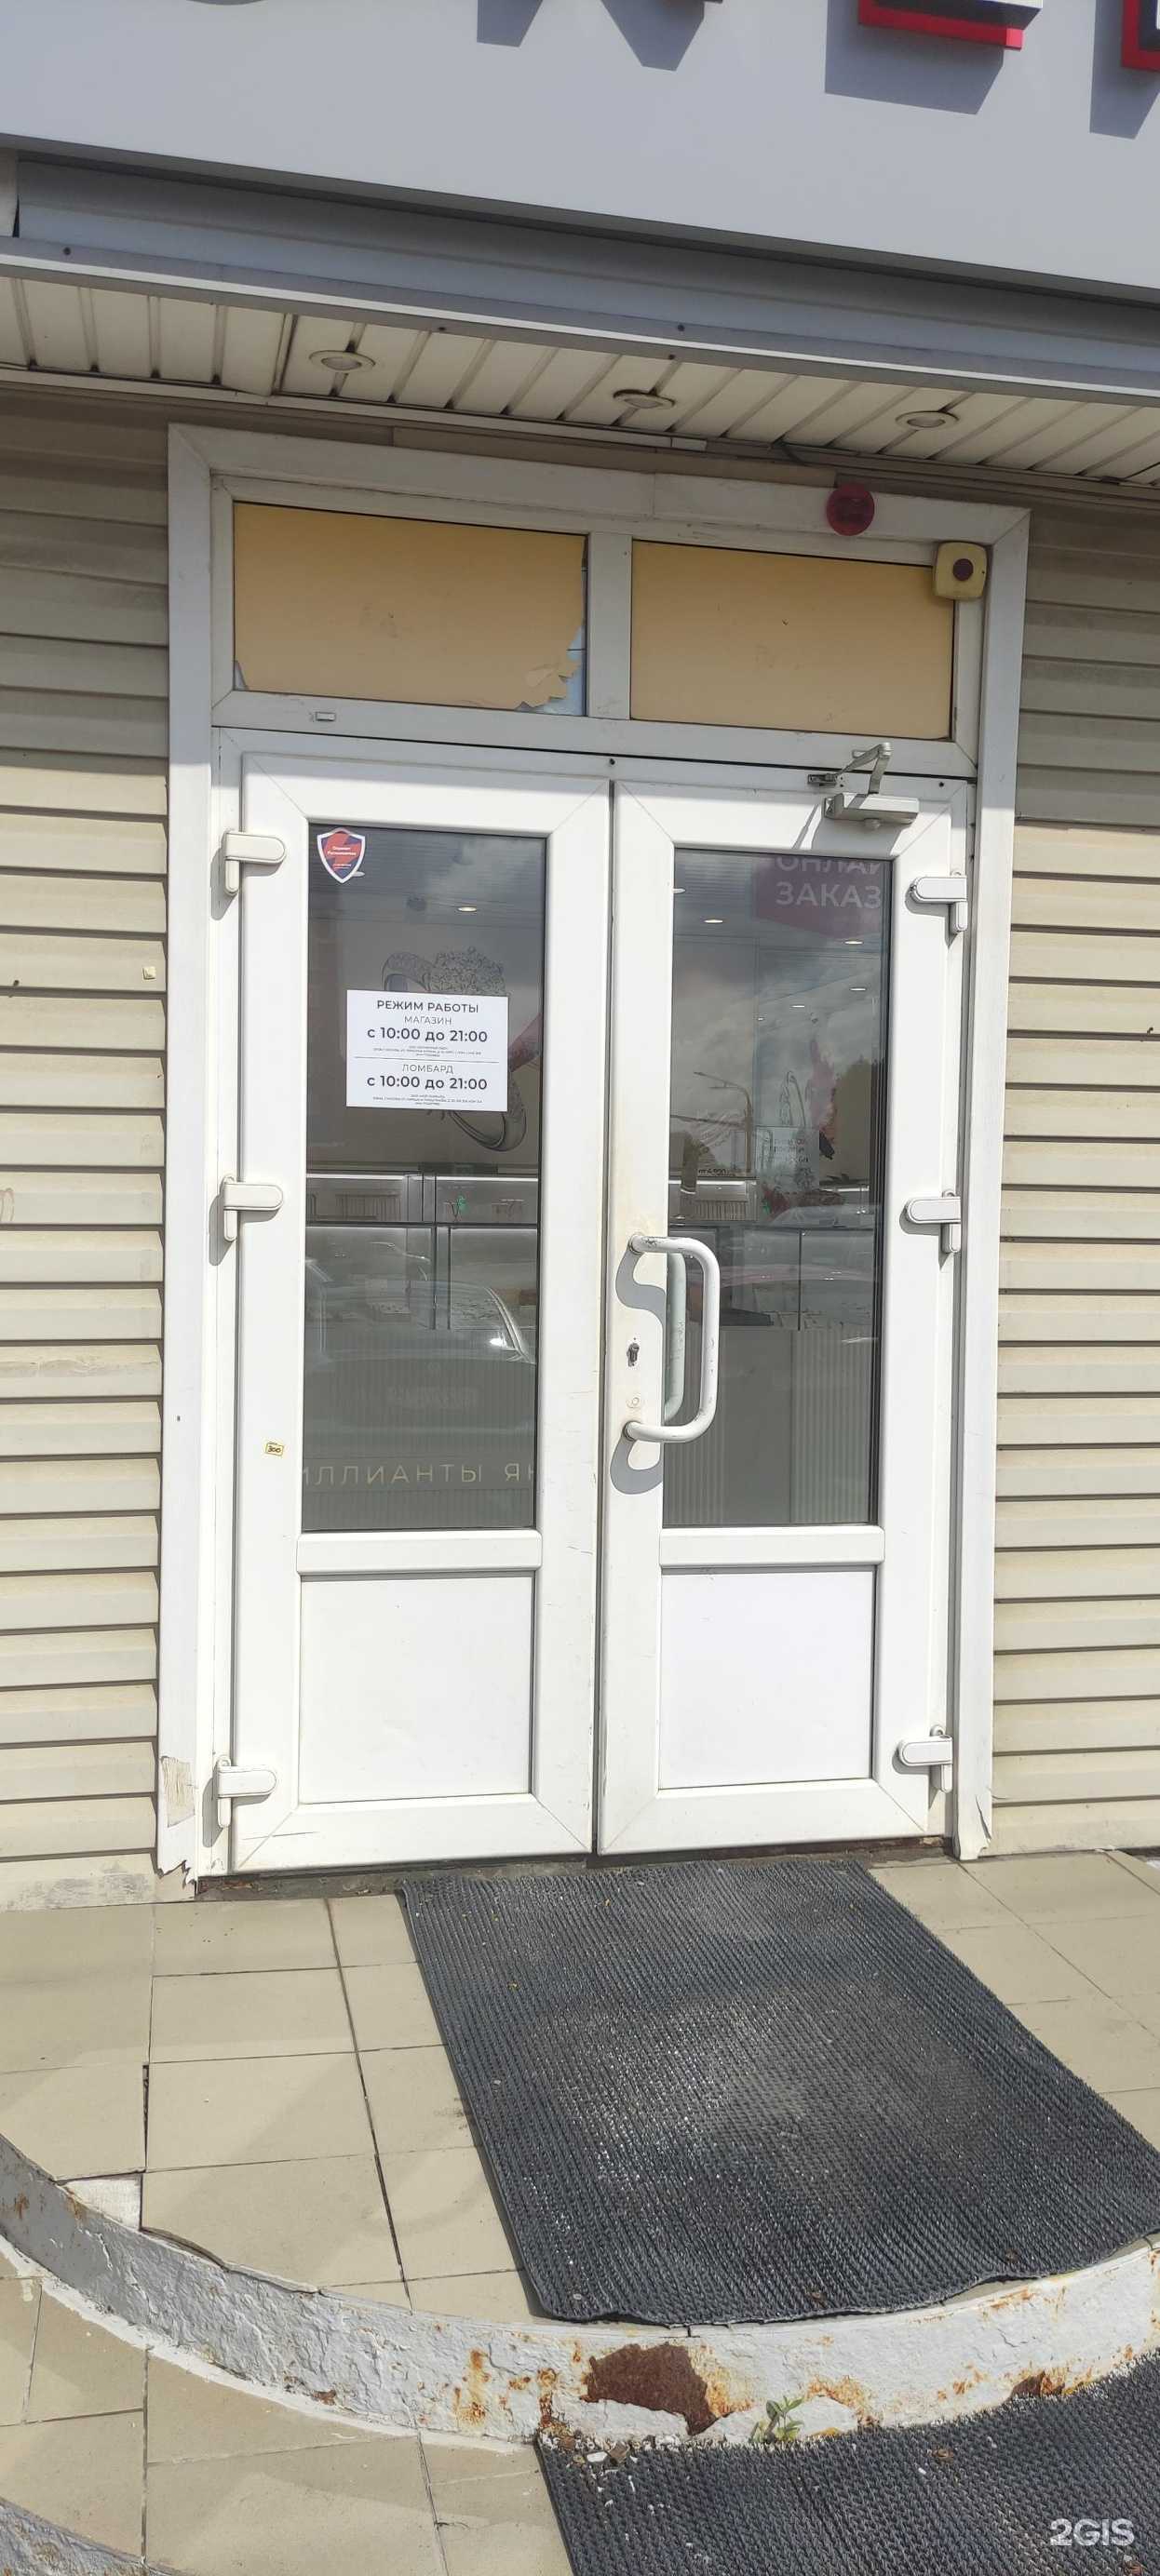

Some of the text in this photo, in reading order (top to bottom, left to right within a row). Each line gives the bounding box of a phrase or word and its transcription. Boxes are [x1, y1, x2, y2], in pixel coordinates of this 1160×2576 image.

[776, 881, 881, 909] ЗАКАЗ
[377, 1000, 479, 1013] РЕЖИМ РАБОТЫ
[404, 1015, 452, 1026] МАГАЗИН
[367, 1026, 488, 1042] с 10:00 до 21:00
[402, 1064, 454, 1075] ЛОМБАРД
[367, 1075, 488, 1090] с 10:00 до 21:00
